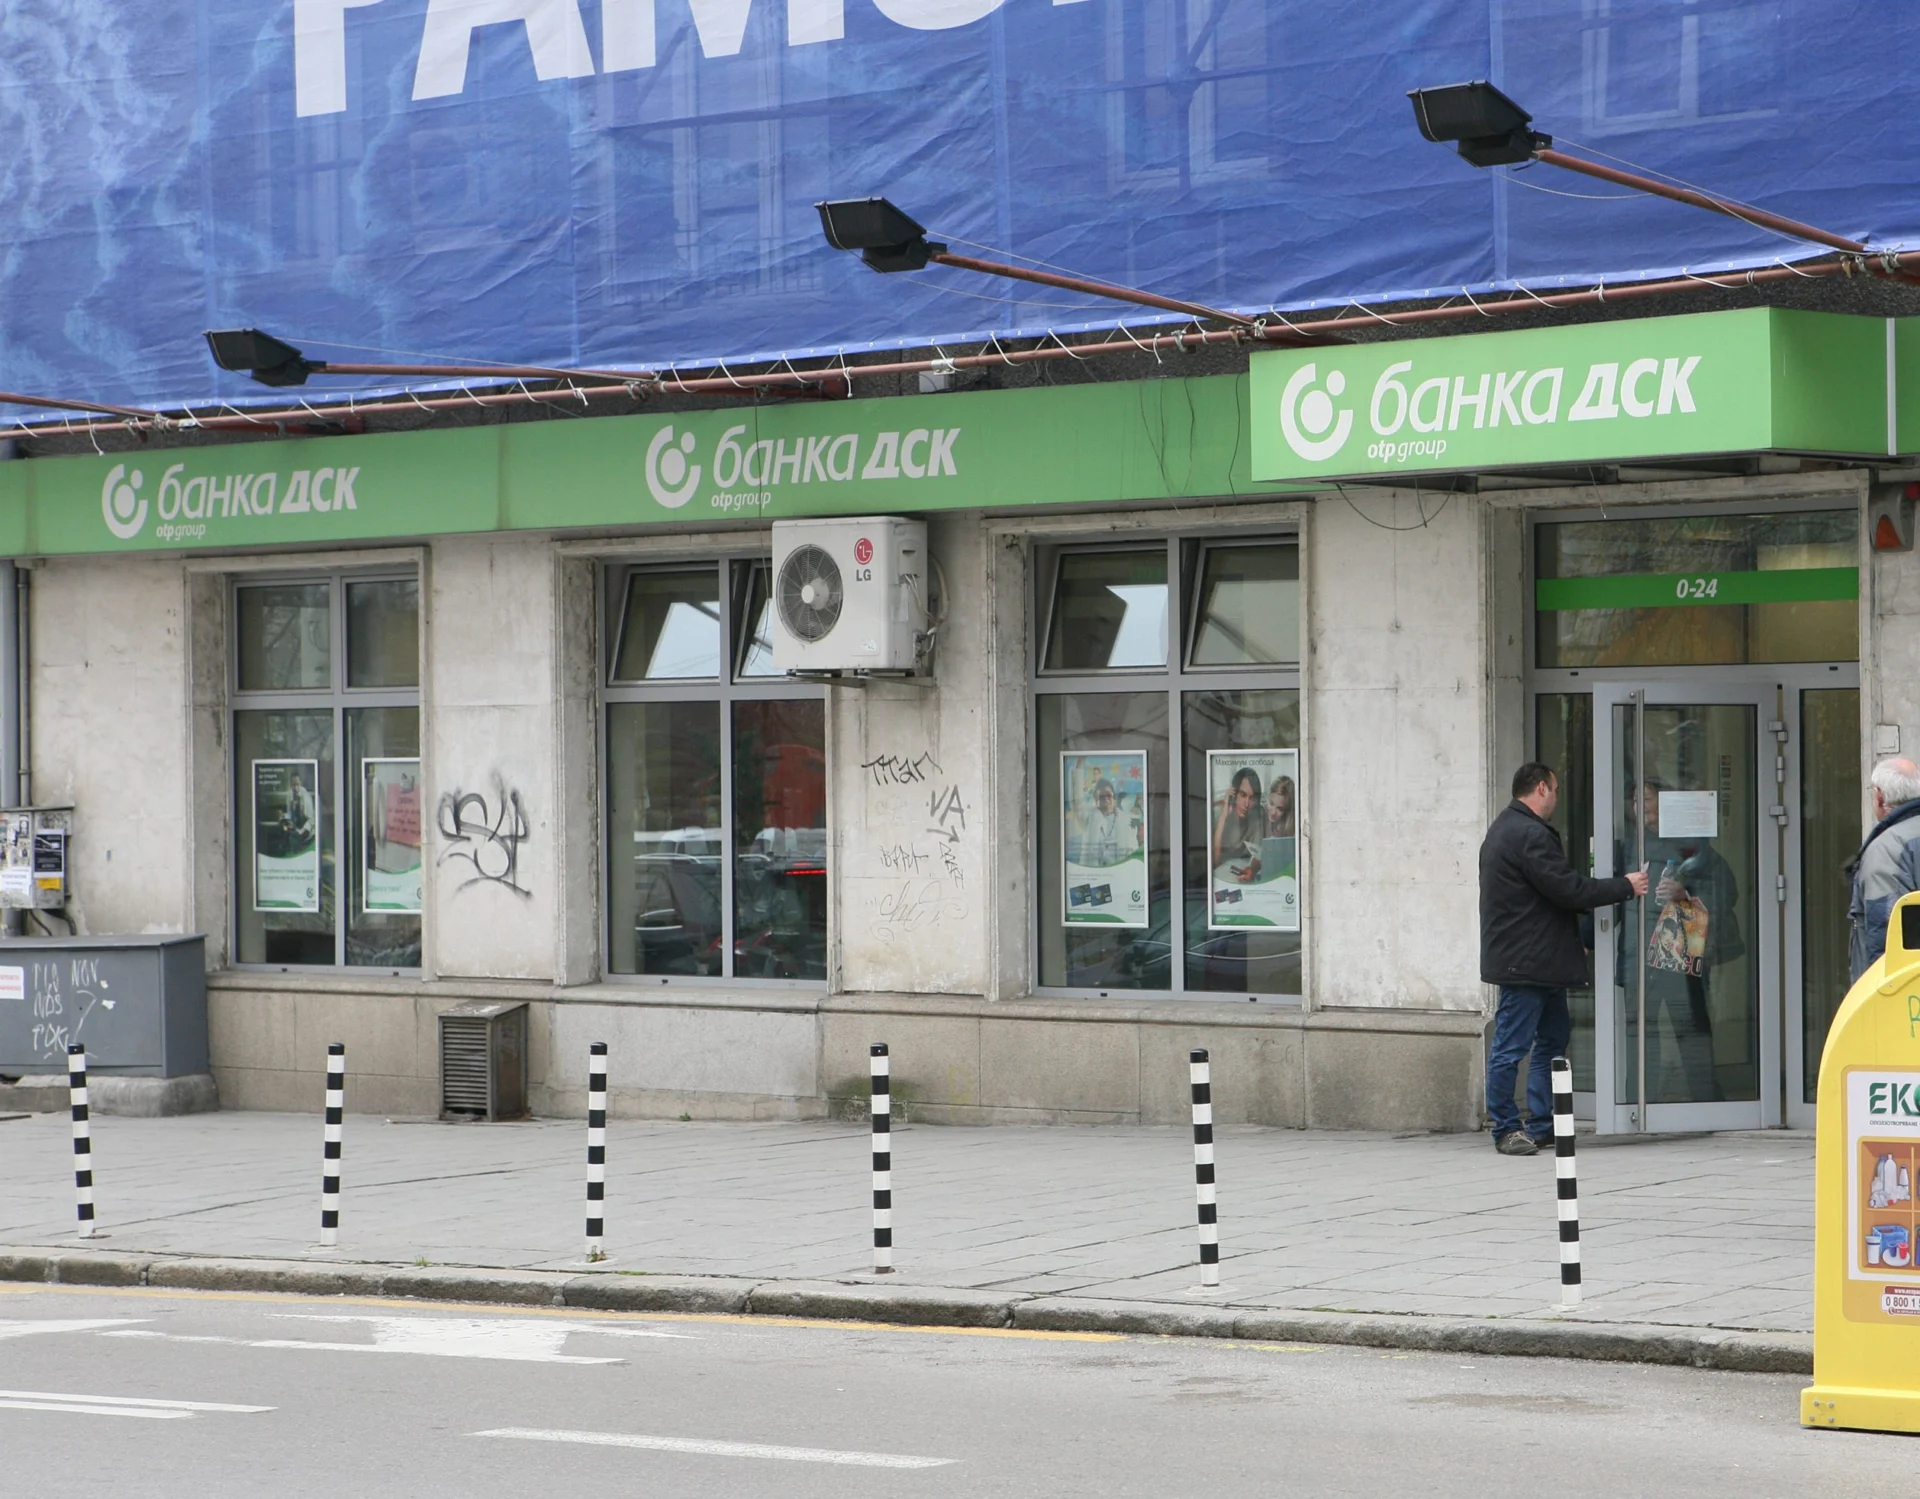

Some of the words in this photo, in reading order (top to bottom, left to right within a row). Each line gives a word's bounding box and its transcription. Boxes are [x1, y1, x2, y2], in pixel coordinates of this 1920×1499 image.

[1369, 360, 1564, 436] банка
[1567, 356, 1702, 422] ДСК
[713, 424, 859, 489] банка
[861, 427, 962, 480] ДСК
[1367, 440, 1396, 463] otp
[1397, 439, 1447, 463] group
[157, 463, 278, 521] банка
[279, 466, 361, 514] ДСК
[711, 490, 733, 512] otp
[733, 490, 772, 512] group
[156, 524, 175, 541] otp
[175, 523, 206, 541] group
[855, 569, 872, 582] LG
[1676, 578, 1718, 599] 0-24
